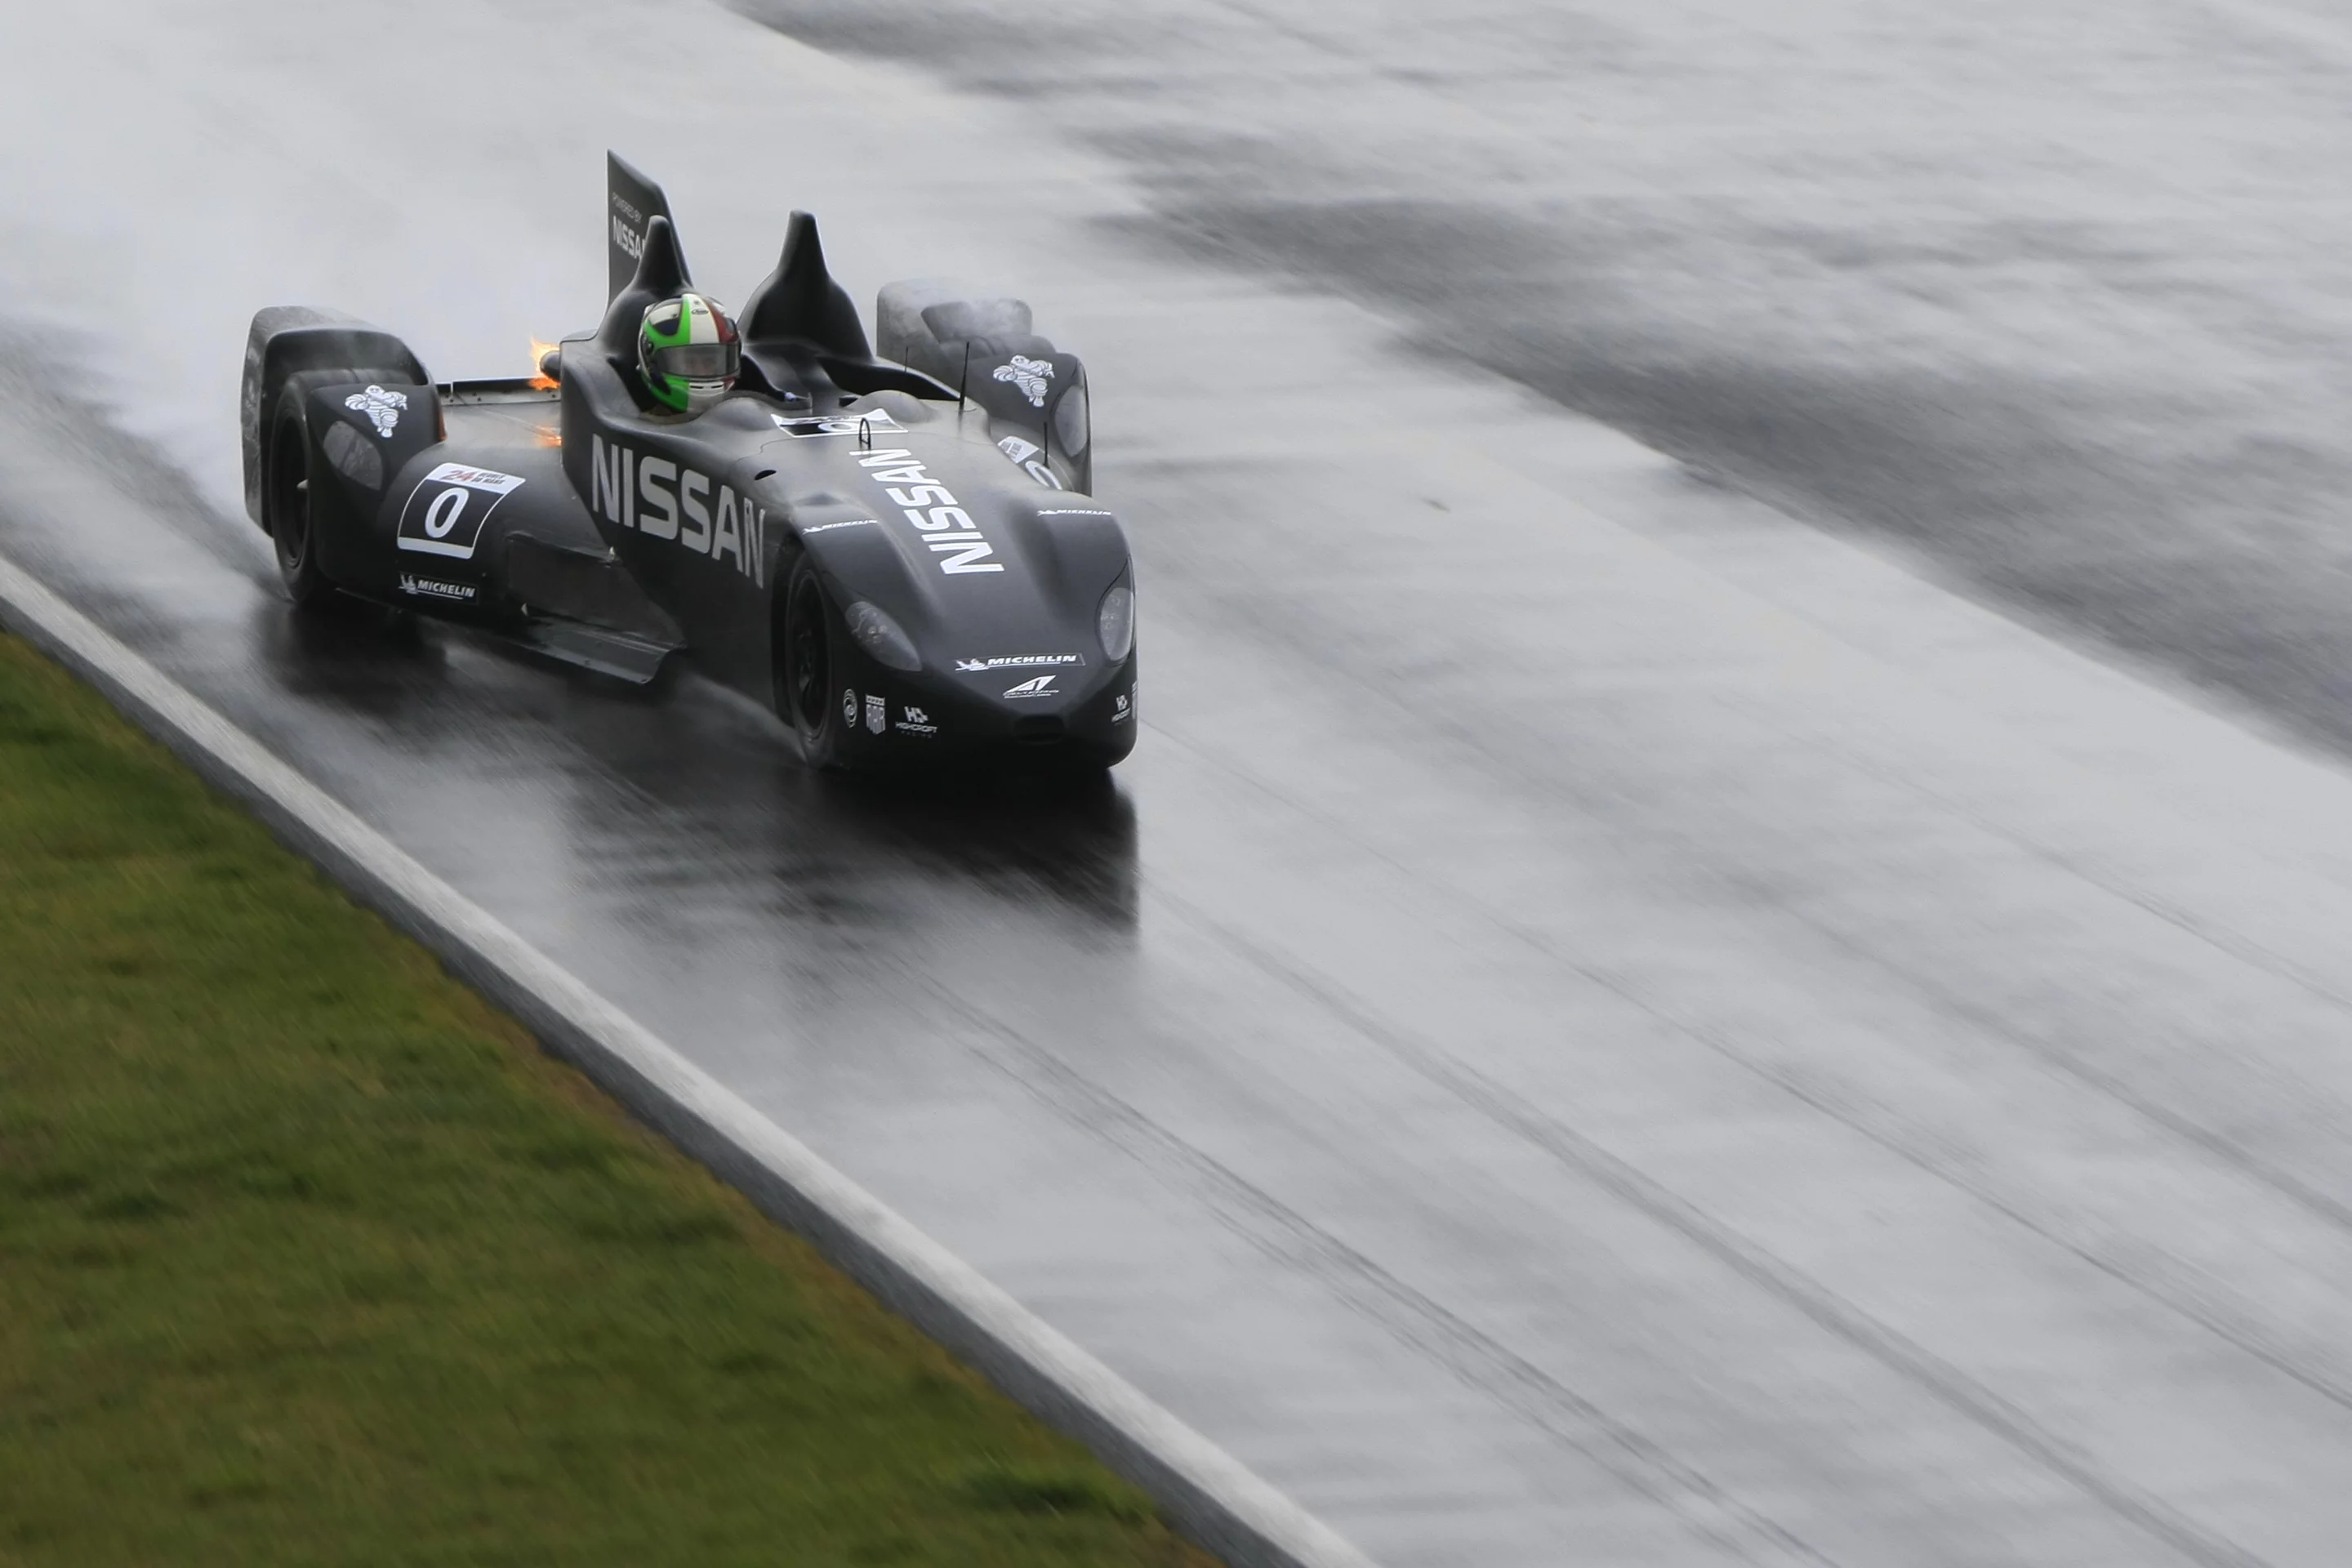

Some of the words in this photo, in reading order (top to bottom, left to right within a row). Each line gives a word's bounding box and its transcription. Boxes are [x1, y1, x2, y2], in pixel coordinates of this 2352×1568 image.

[425, 488, 470, 539] 0
[592, 433, 766, 590] NISSAN
[849, 448, 1005, 575] NISSAN
[417, 579, 476, 598] MICHELIN
[987, 654, 1077, 666] MICHELIN
